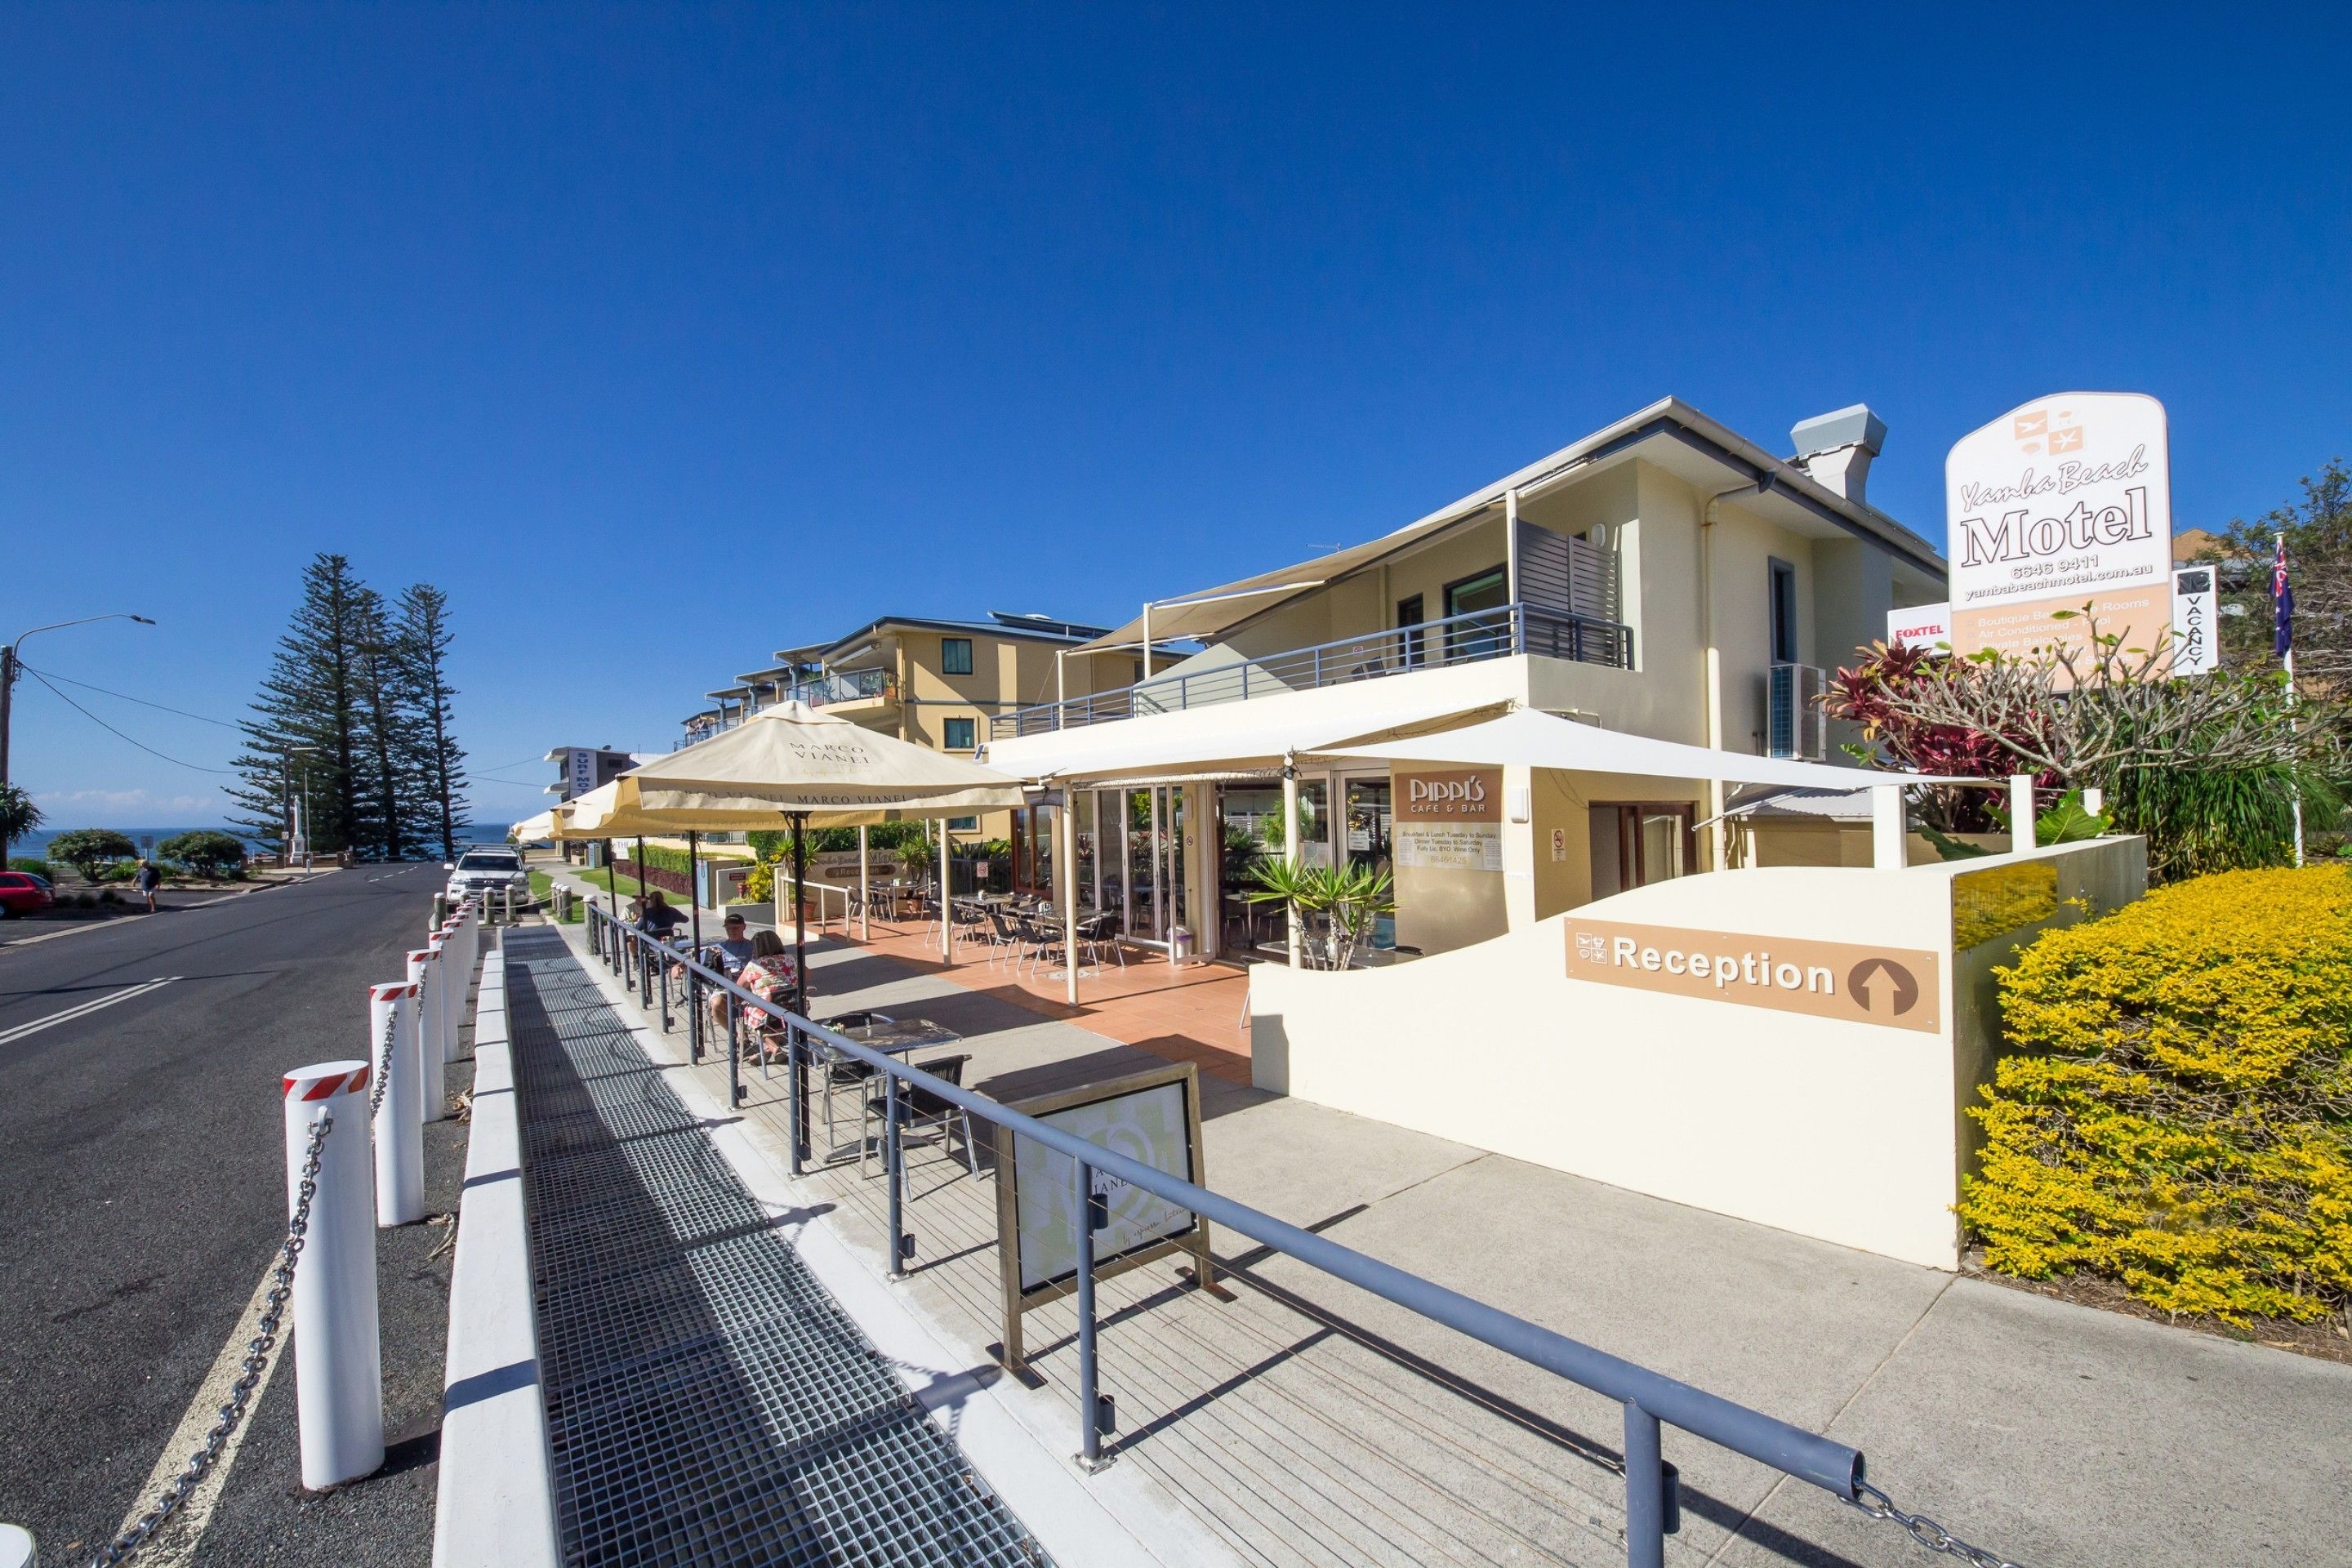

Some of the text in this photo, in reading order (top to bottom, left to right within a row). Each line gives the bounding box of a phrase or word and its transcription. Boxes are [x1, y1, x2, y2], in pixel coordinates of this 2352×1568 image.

[1961, 443, 2149, 512] Yamba Beach
[1960, 486, 2152, 568] Motel
[2011, 555, 2099, 579] 6646 9411
[1965, 564, 2153, 601] yambabeachmotel.com.au
[1978, 599, 2149, 628] Boutique Rooms
[1895, 625, 1944, 639] FOXTEL
[1979, 629, 1994, 639] Air
[1998, 621, 2069, 637] Conditioned
[2187, 595, 2203, 666] VACANCY
[790, 742, 863, 752] MARCO
[797, 795, 850, 804] MARCO
[1446, 804, 1454, 813] &
[1461, 804, 1486, 813] BAR
[1613, 936, 1836, 996] Reception
